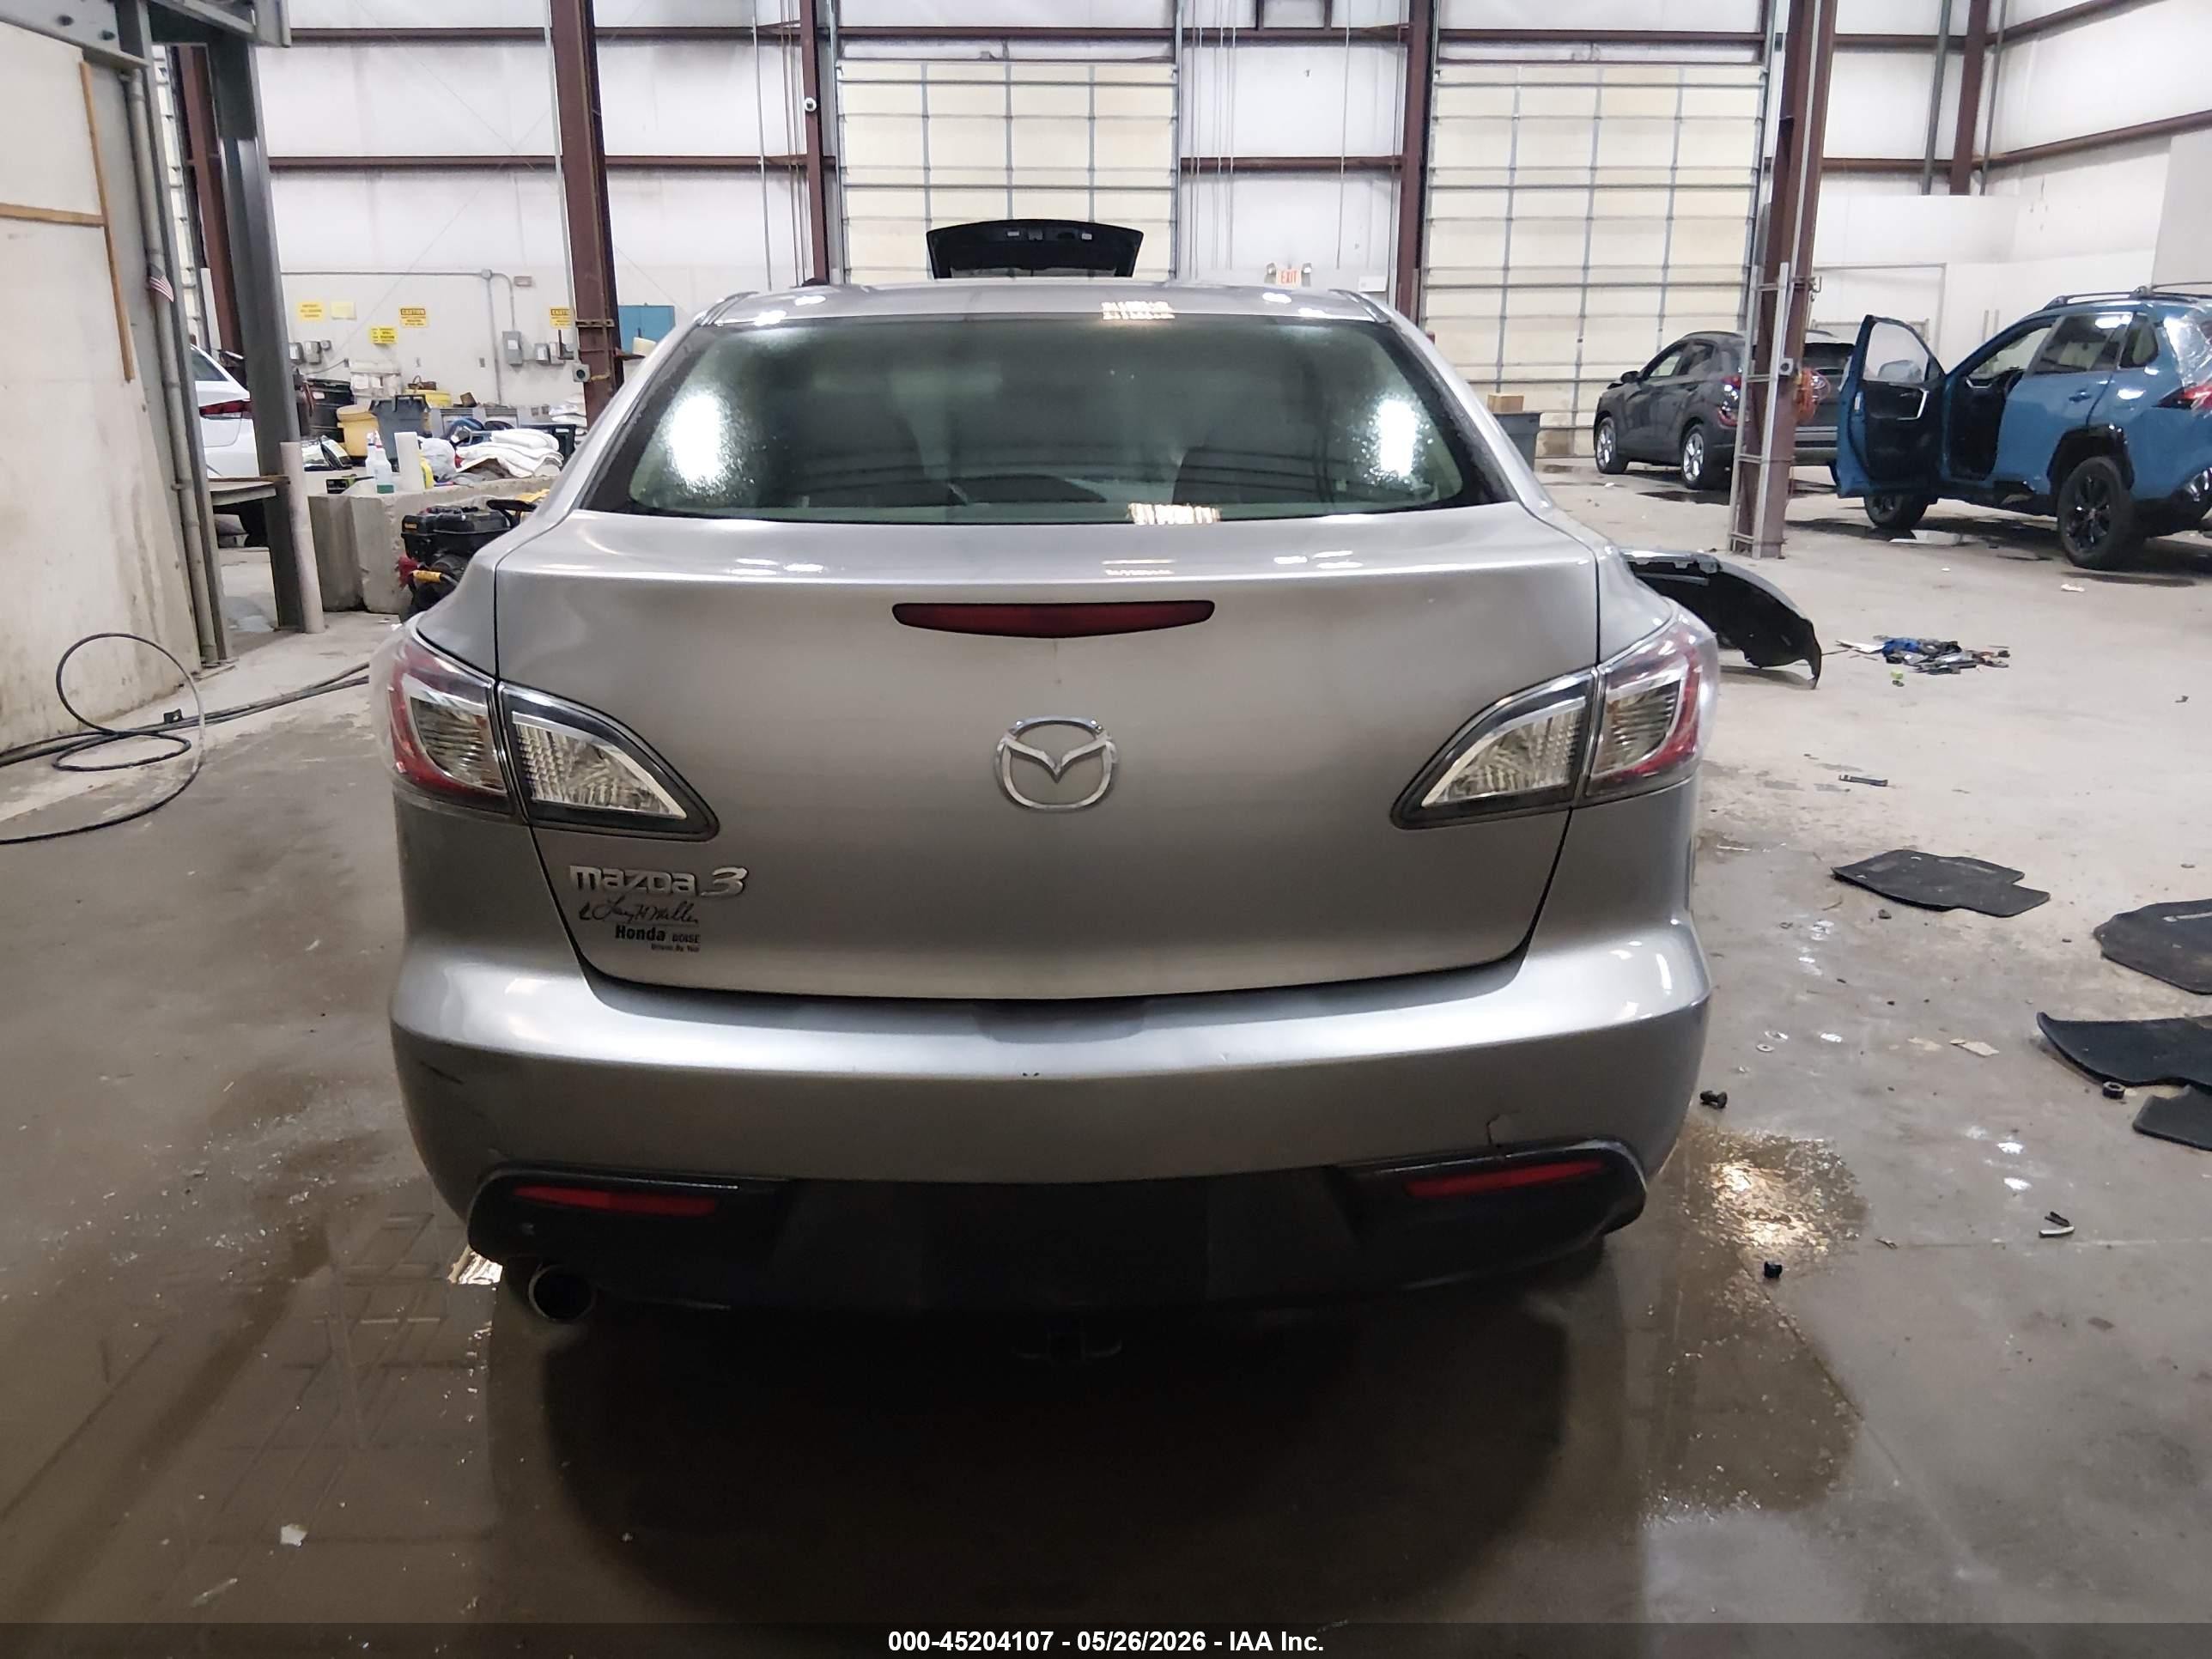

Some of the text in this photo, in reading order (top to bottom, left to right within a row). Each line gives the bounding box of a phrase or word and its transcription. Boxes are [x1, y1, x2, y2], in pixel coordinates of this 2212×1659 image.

[1281, 270, 1297, 283] EXIT
[700, 866, 749, 897] 3
[615, 925, 701, 944] Honda BOISE
